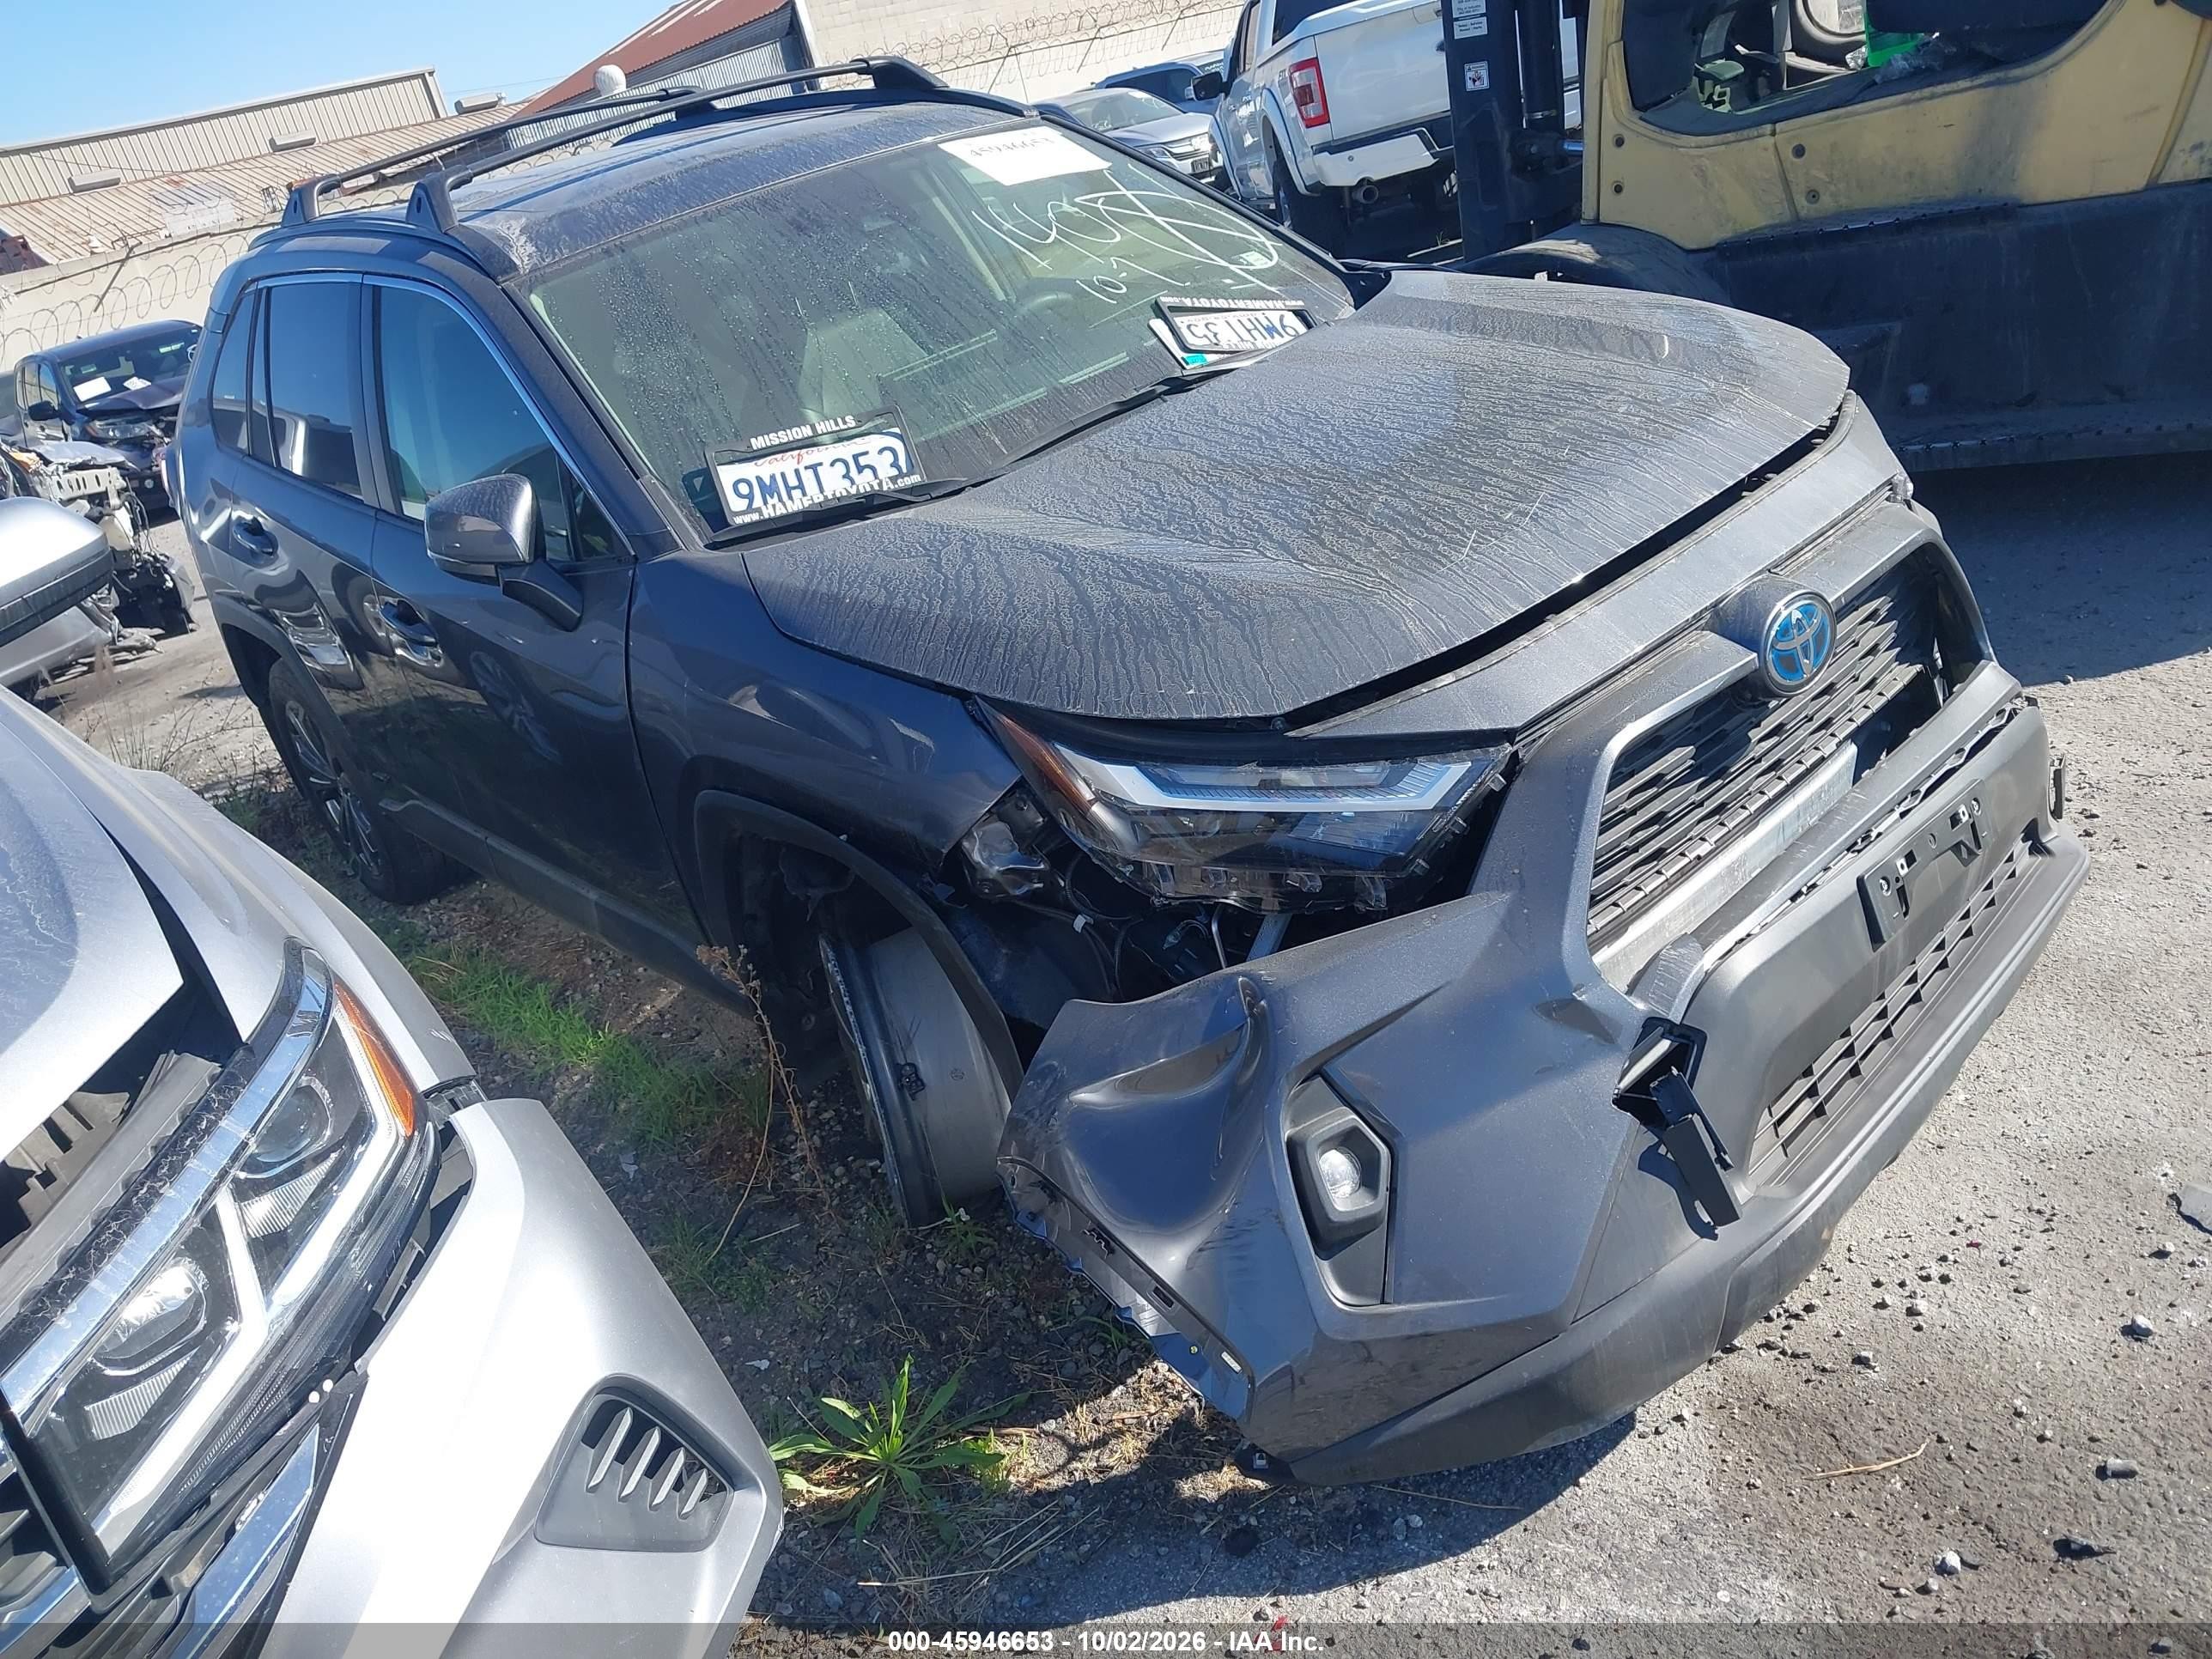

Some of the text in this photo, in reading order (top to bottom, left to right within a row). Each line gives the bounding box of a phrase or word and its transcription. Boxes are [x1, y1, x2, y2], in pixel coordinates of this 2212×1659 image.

[1187, 313, 1300, 345] 9MHT35
[750, 415, 856, 450] MISSION HILLS
[732, 445, 905, 512] 9MHT353
[733, 472, 923, 526] www.HAMERTOYOTA.com
